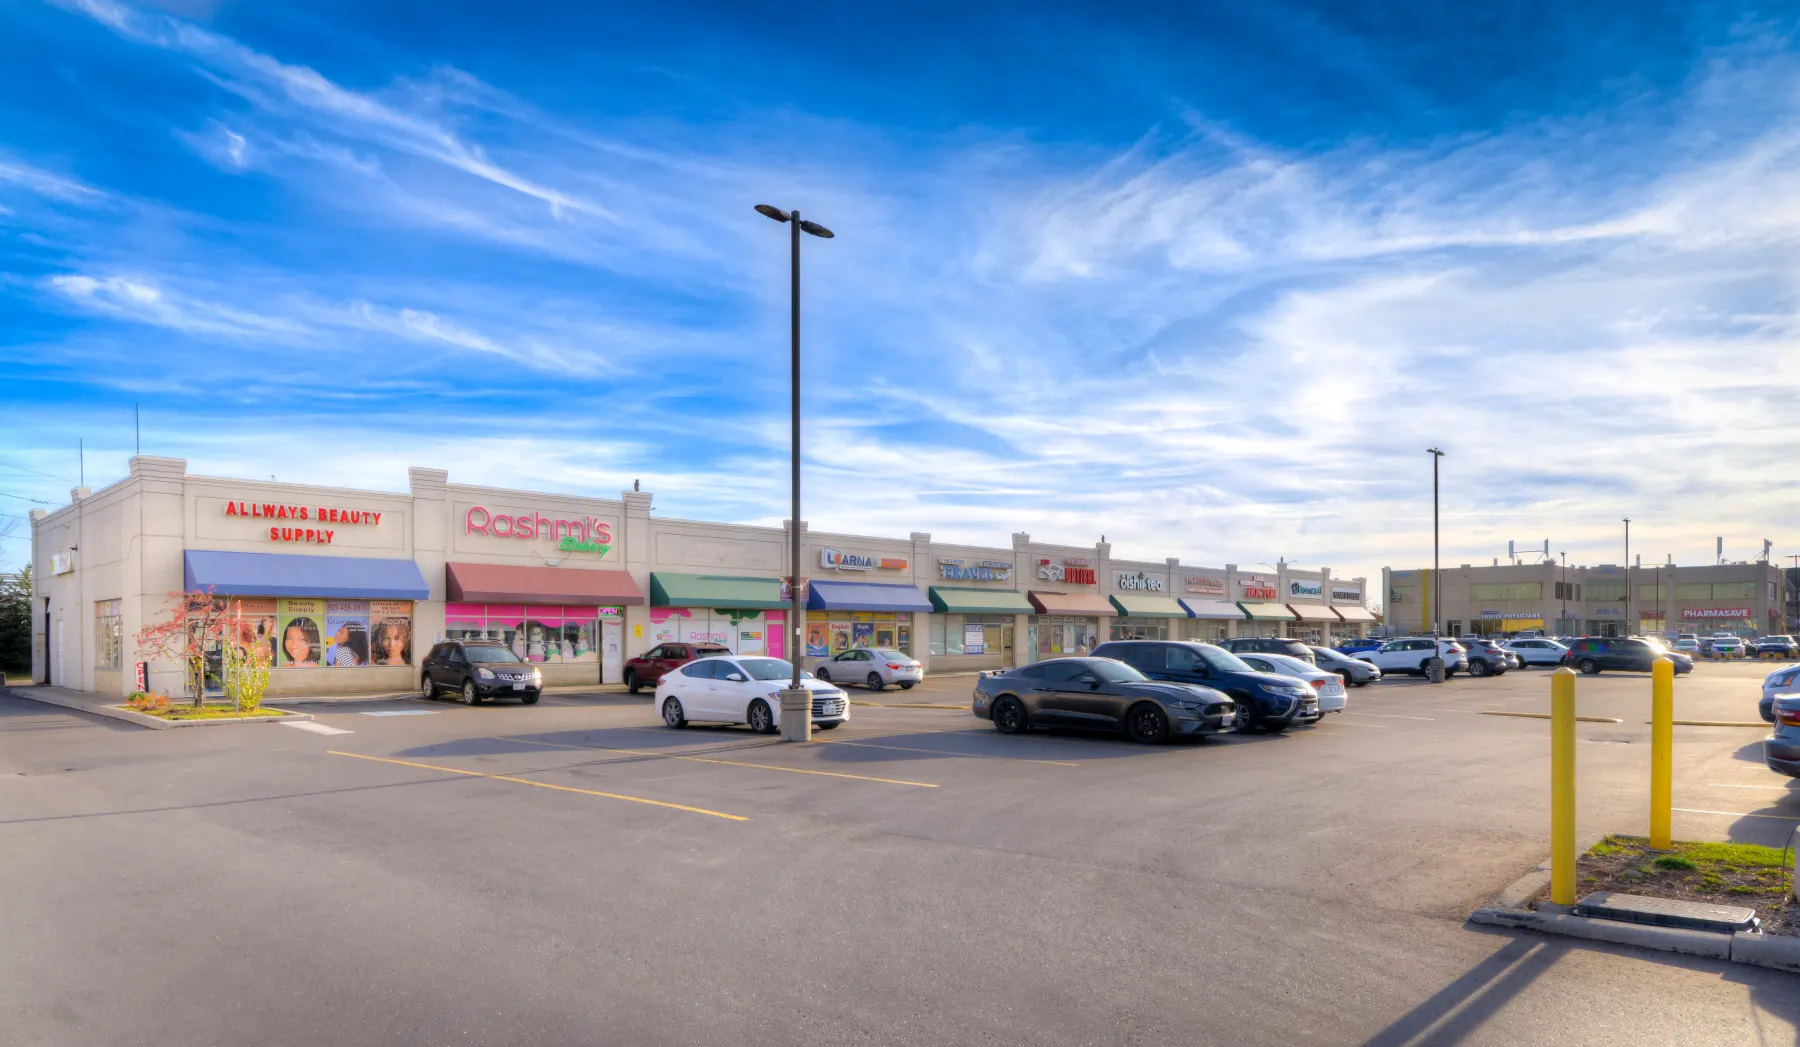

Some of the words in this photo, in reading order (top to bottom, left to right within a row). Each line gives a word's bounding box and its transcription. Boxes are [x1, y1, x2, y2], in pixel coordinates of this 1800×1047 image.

[225, 501, 308, 520] ALLWAYS
[317, 508, 381, 525] BEAUTY
[465, 506, 612, 544] Rashmi's
[269, 527, 334, 543] SUPPLY
[943, 565, 993, 580] TRAVEL
[327, 603, 368, 611] 905-456-3970
[598, 607, 618, 615] OPEN
[1684, 609, 1748, 617] PHARMASAVE
[831, 623, 850, 631] English
[690, 632, 728, 641] Rashmi's
[136, 661, 146, 691] OPEN
